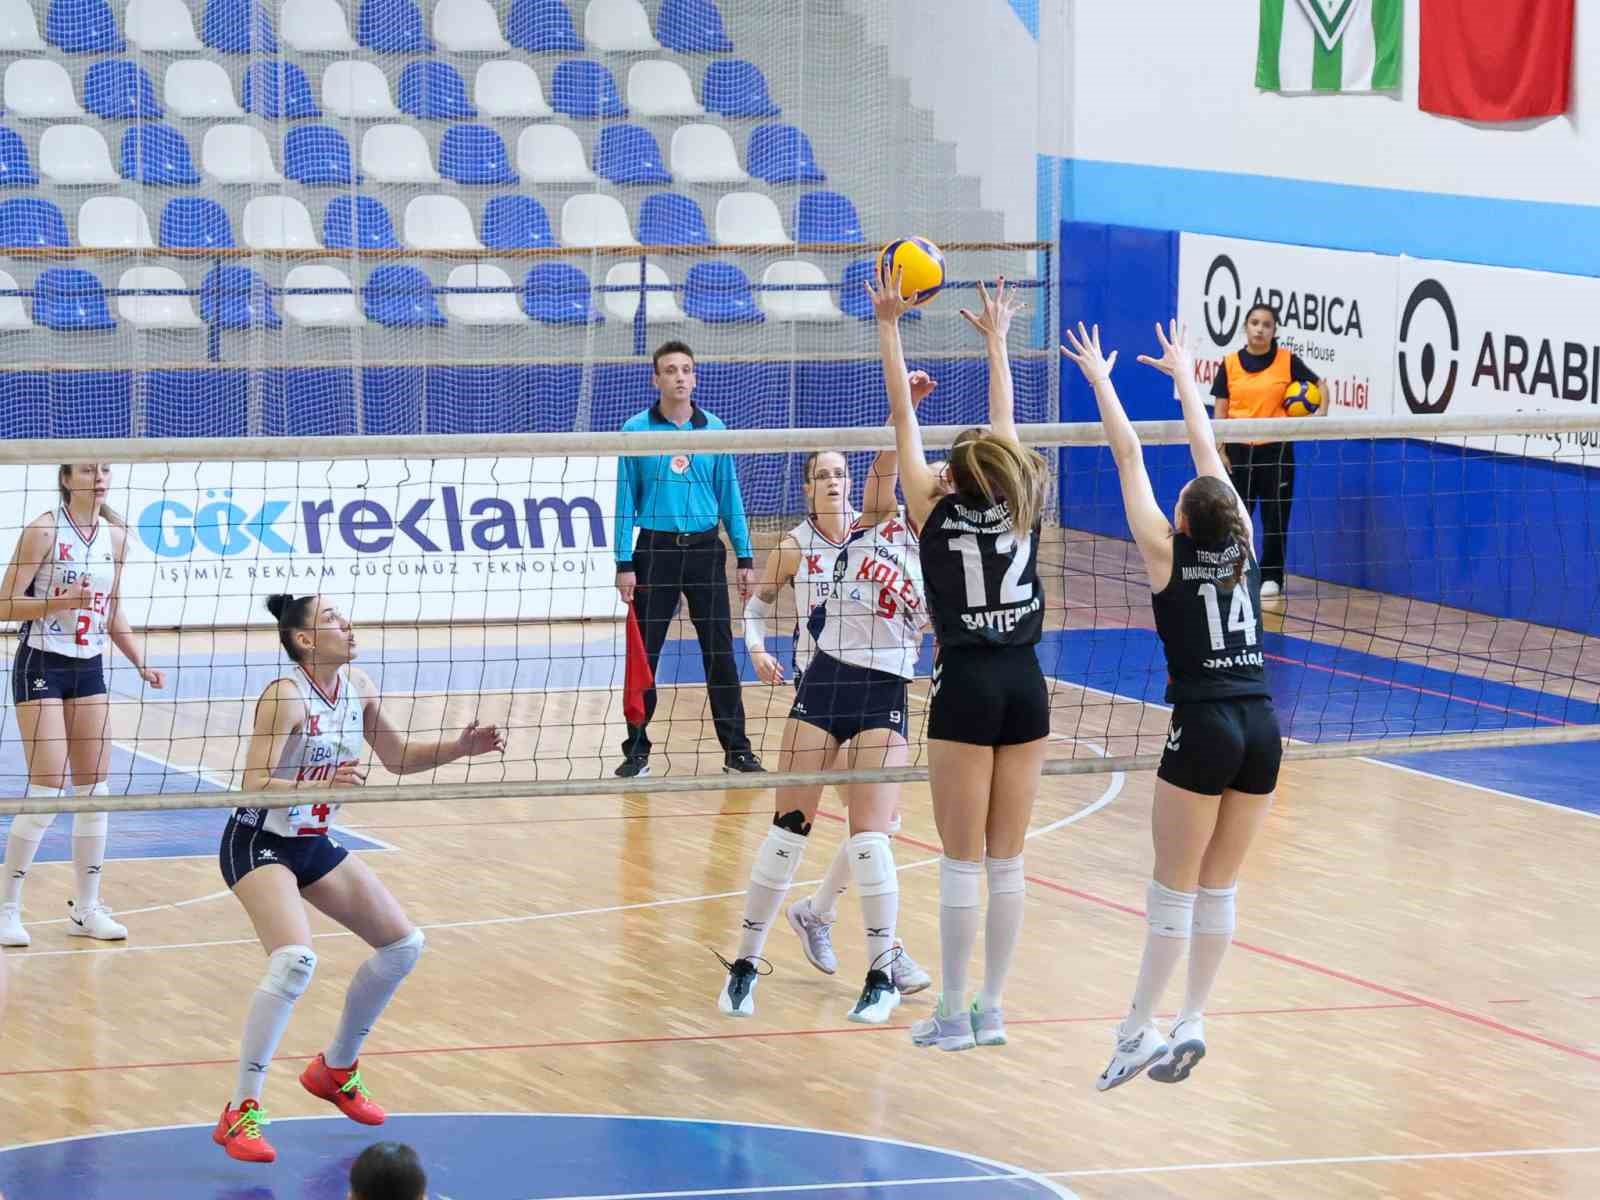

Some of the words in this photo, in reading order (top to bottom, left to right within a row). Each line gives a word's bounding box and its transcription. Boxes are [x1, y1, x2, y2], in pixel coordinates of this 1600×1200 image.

[1306, 341, 1336, 362] House
[880, 520, 904, 543] K
[59, 543, 74, 562] K
[160, 565, 233, 582] İŞİMİZ
[248, 564, 336, 579] REKLAM
[472, 557, 597, 575] TEKNOLOJİ
[805, 554, 823, 575] K
[948, 529, 1033, 608] 12
[876, 588, 898, 620] 9
[1197, 582, 1258, 651] 14
[75, 615, 91, 646] 2
[888, 710, 901, 724] 9
[311, 803, 330, 823] 4
